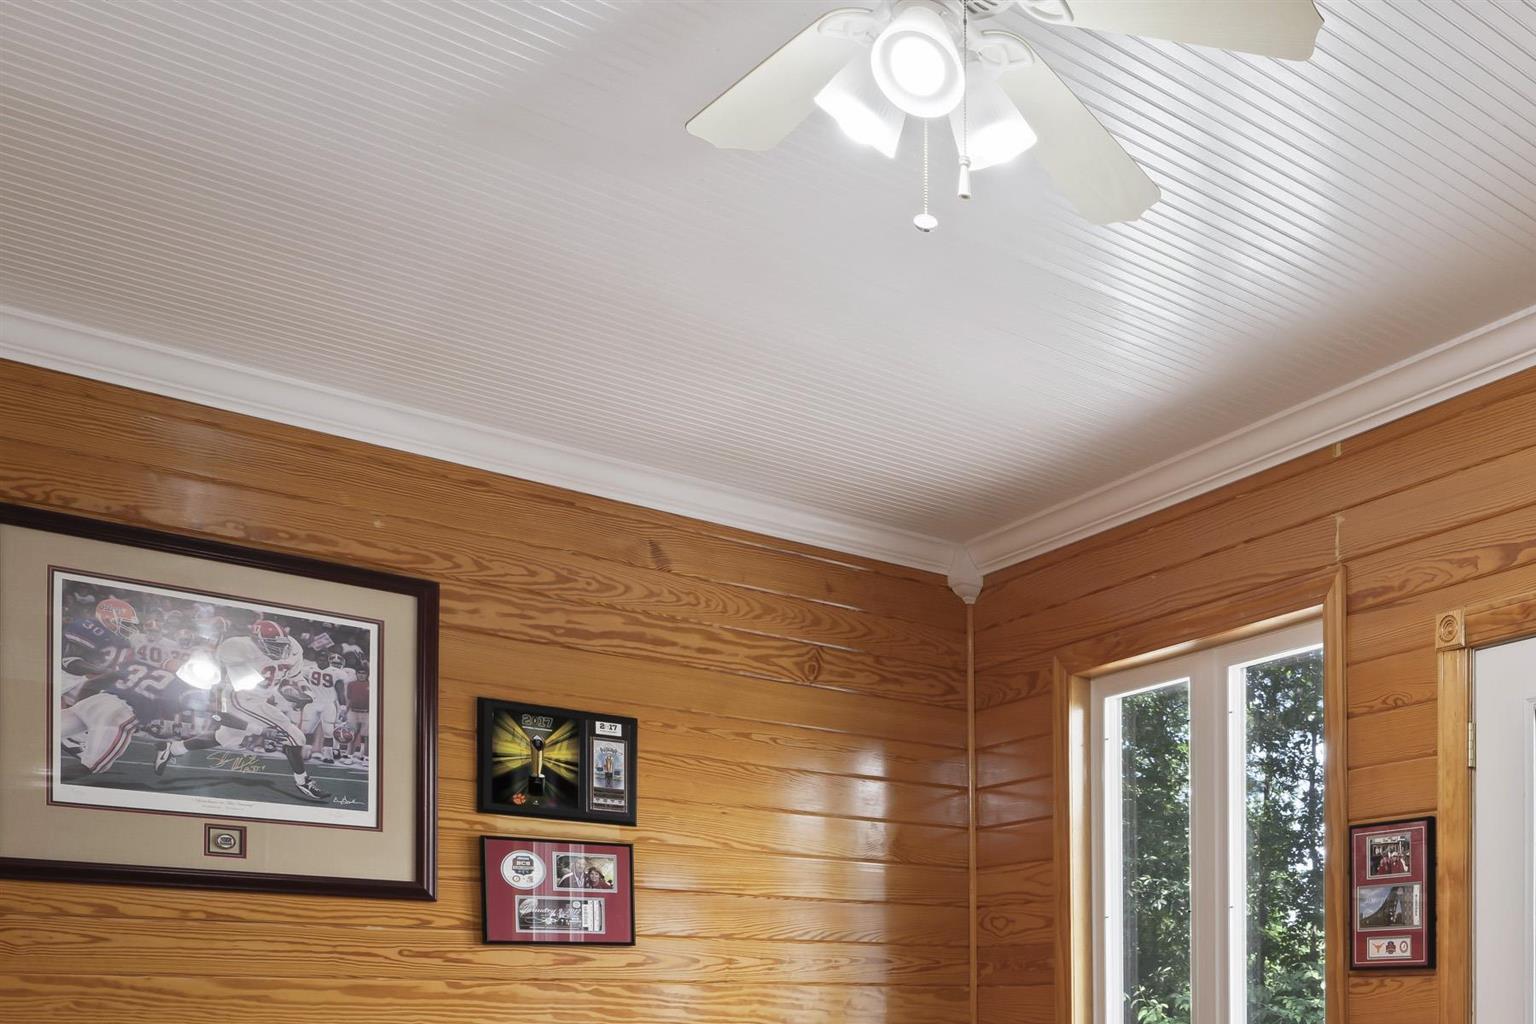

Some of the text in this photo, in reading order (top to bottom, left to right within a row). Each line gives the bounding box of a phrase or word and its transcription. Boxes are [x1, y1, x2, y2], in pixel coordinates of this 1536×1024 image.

[115, 664, 176, 700] 32
[311, 671, 335, 688] 99
[522, 713, 553, 729] 2017
